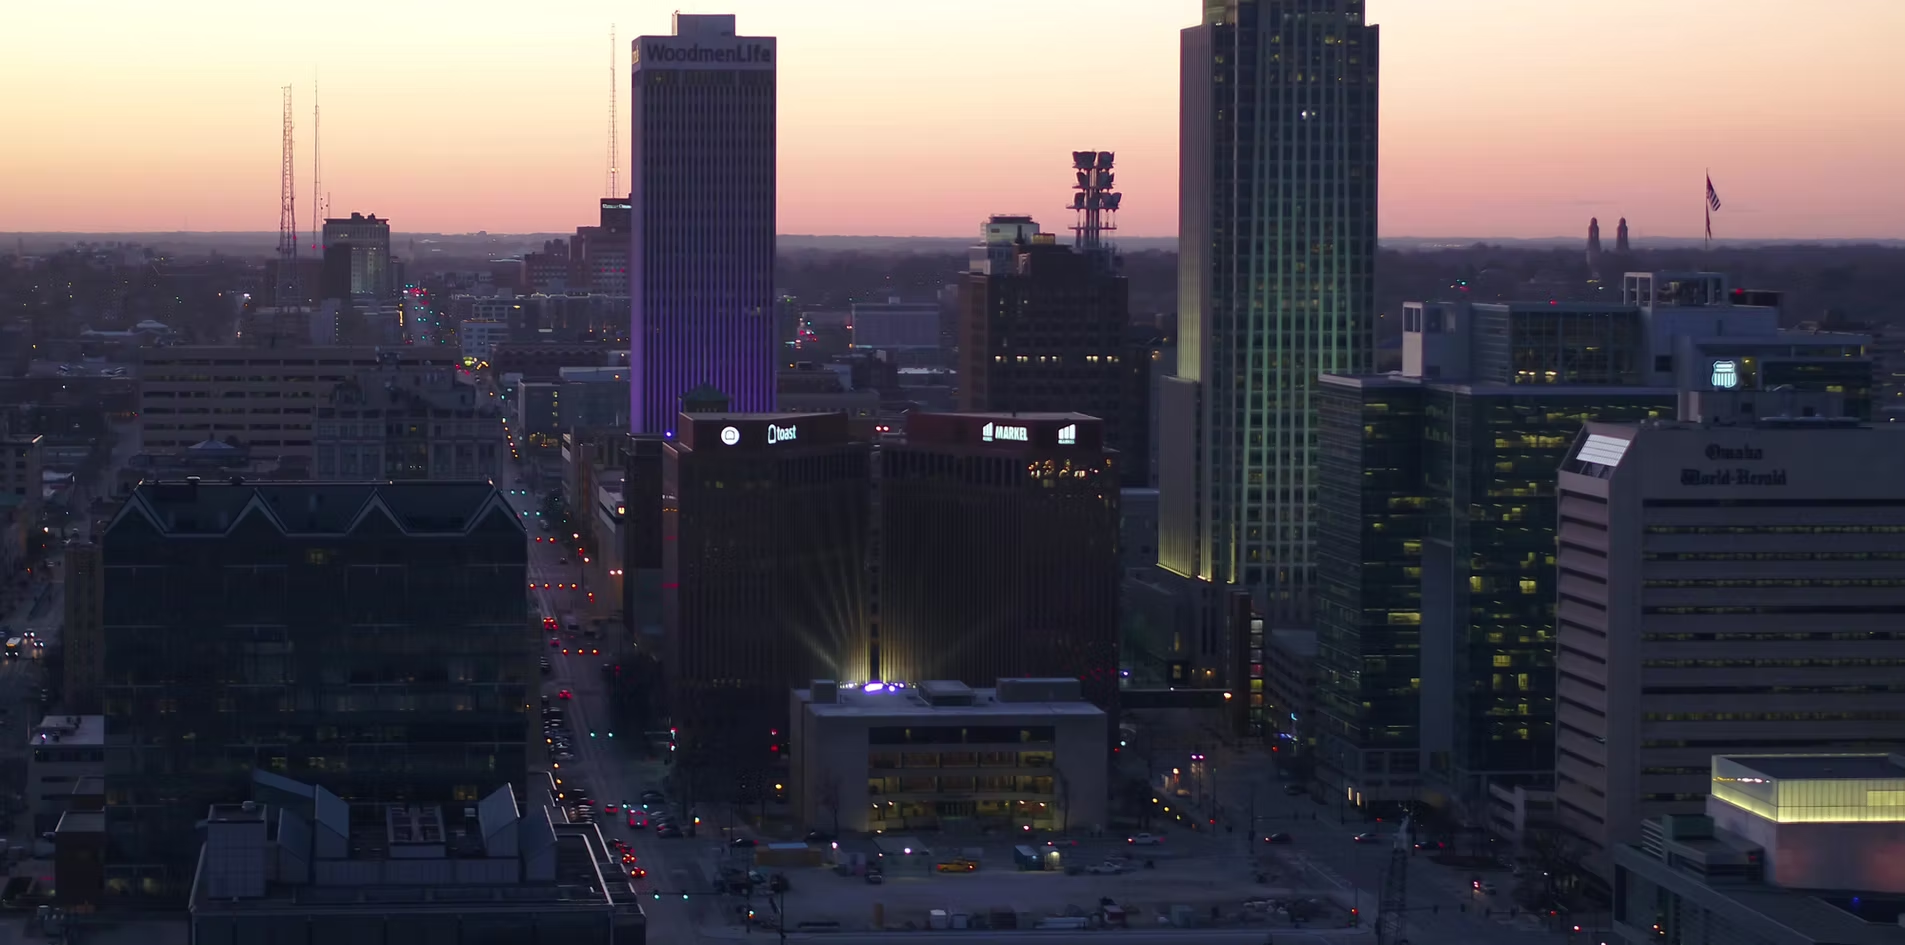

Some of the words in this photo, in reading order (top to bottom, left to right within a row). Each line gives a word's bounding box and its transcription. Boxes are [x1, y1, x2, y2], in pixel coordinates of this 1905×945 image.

[647, 43, 770, 62] WoodmenLife
[777, 424, 796, 441] toast
[995, 426, 1028, 441] MARKEL
[1705, 443, 1762, 460] Omaha
[1681, 468, 1786, 485] World-Herald
